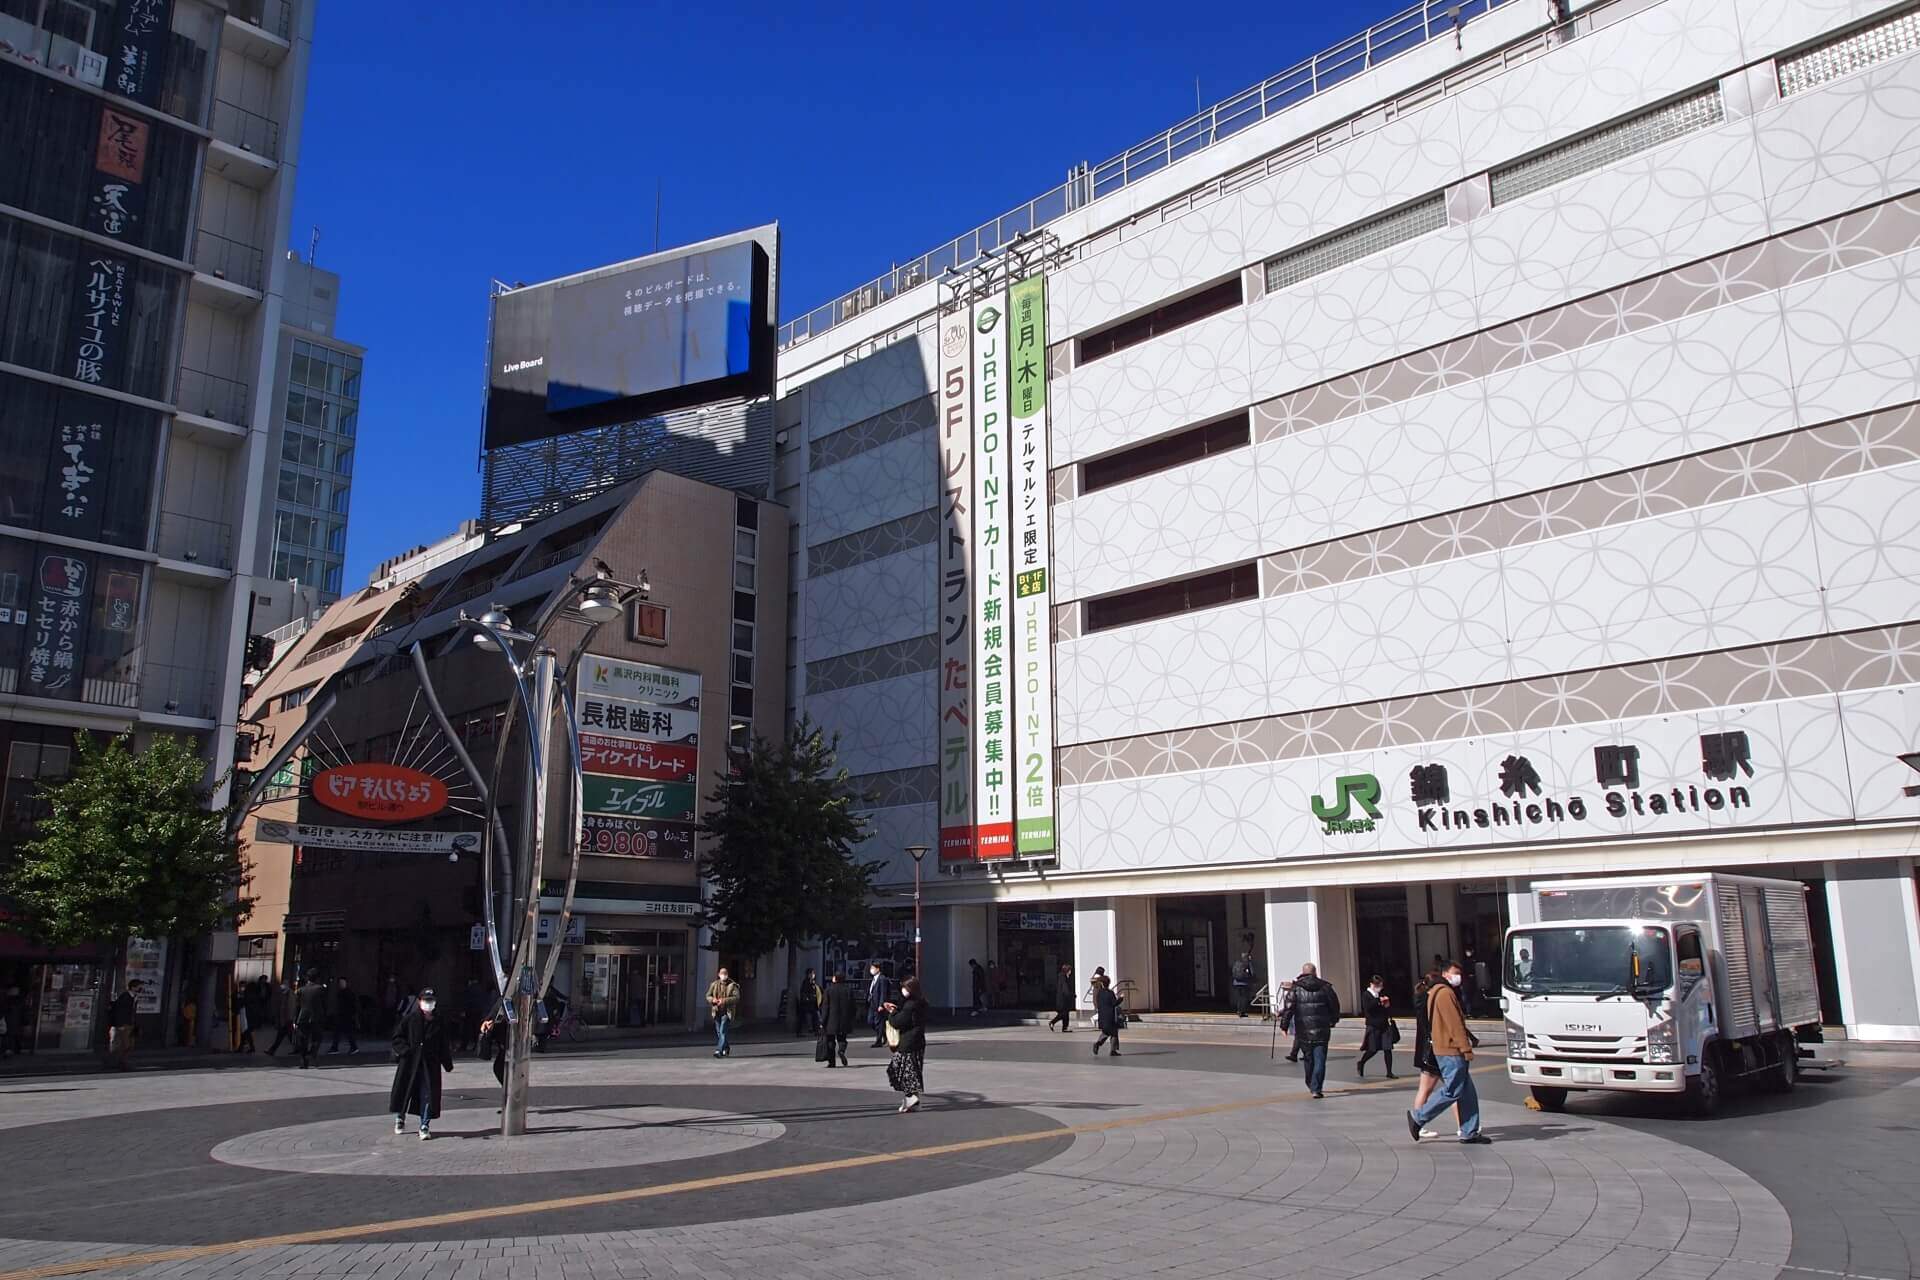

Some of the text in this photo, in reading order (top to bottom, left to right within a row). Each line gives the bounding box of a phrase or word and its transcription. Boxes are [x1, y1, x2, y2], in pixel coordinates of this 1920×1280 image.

[74, 258, 113, 383] ベルサイユの豚
[504, 356, 543, 373] Live Board
[984, 338, 997, 403] JRE
[61, 505, 84, 518] 4F
[1020, 580, 1042, 596] 全店
[30, 596, 57, 682] セセリ焼き
[53, 599, 81, 670] 赤から鍋
[638, 686, 680, 700] クリニック
[1025, 601, 1044, 808] JRE POINT 2倍
[582, 701, 673, 737] 長根歯科
[581, 747, 686, 774] テイケイトレード
[600, 785, 666, 815] エイブル
[1311, 773, 1384, 822] JR
[1418, 785, 1751, 833] Kinshichō Station
[980, 834, 1010, 845] TERMINA
[1021, 829, 1050, 840] TERMINA
[684, 850, 694, 859] 2F
[645, 903, 694, 915] 三井住友銀行
[1564, 1022, 1602, 1033] ISUZU
